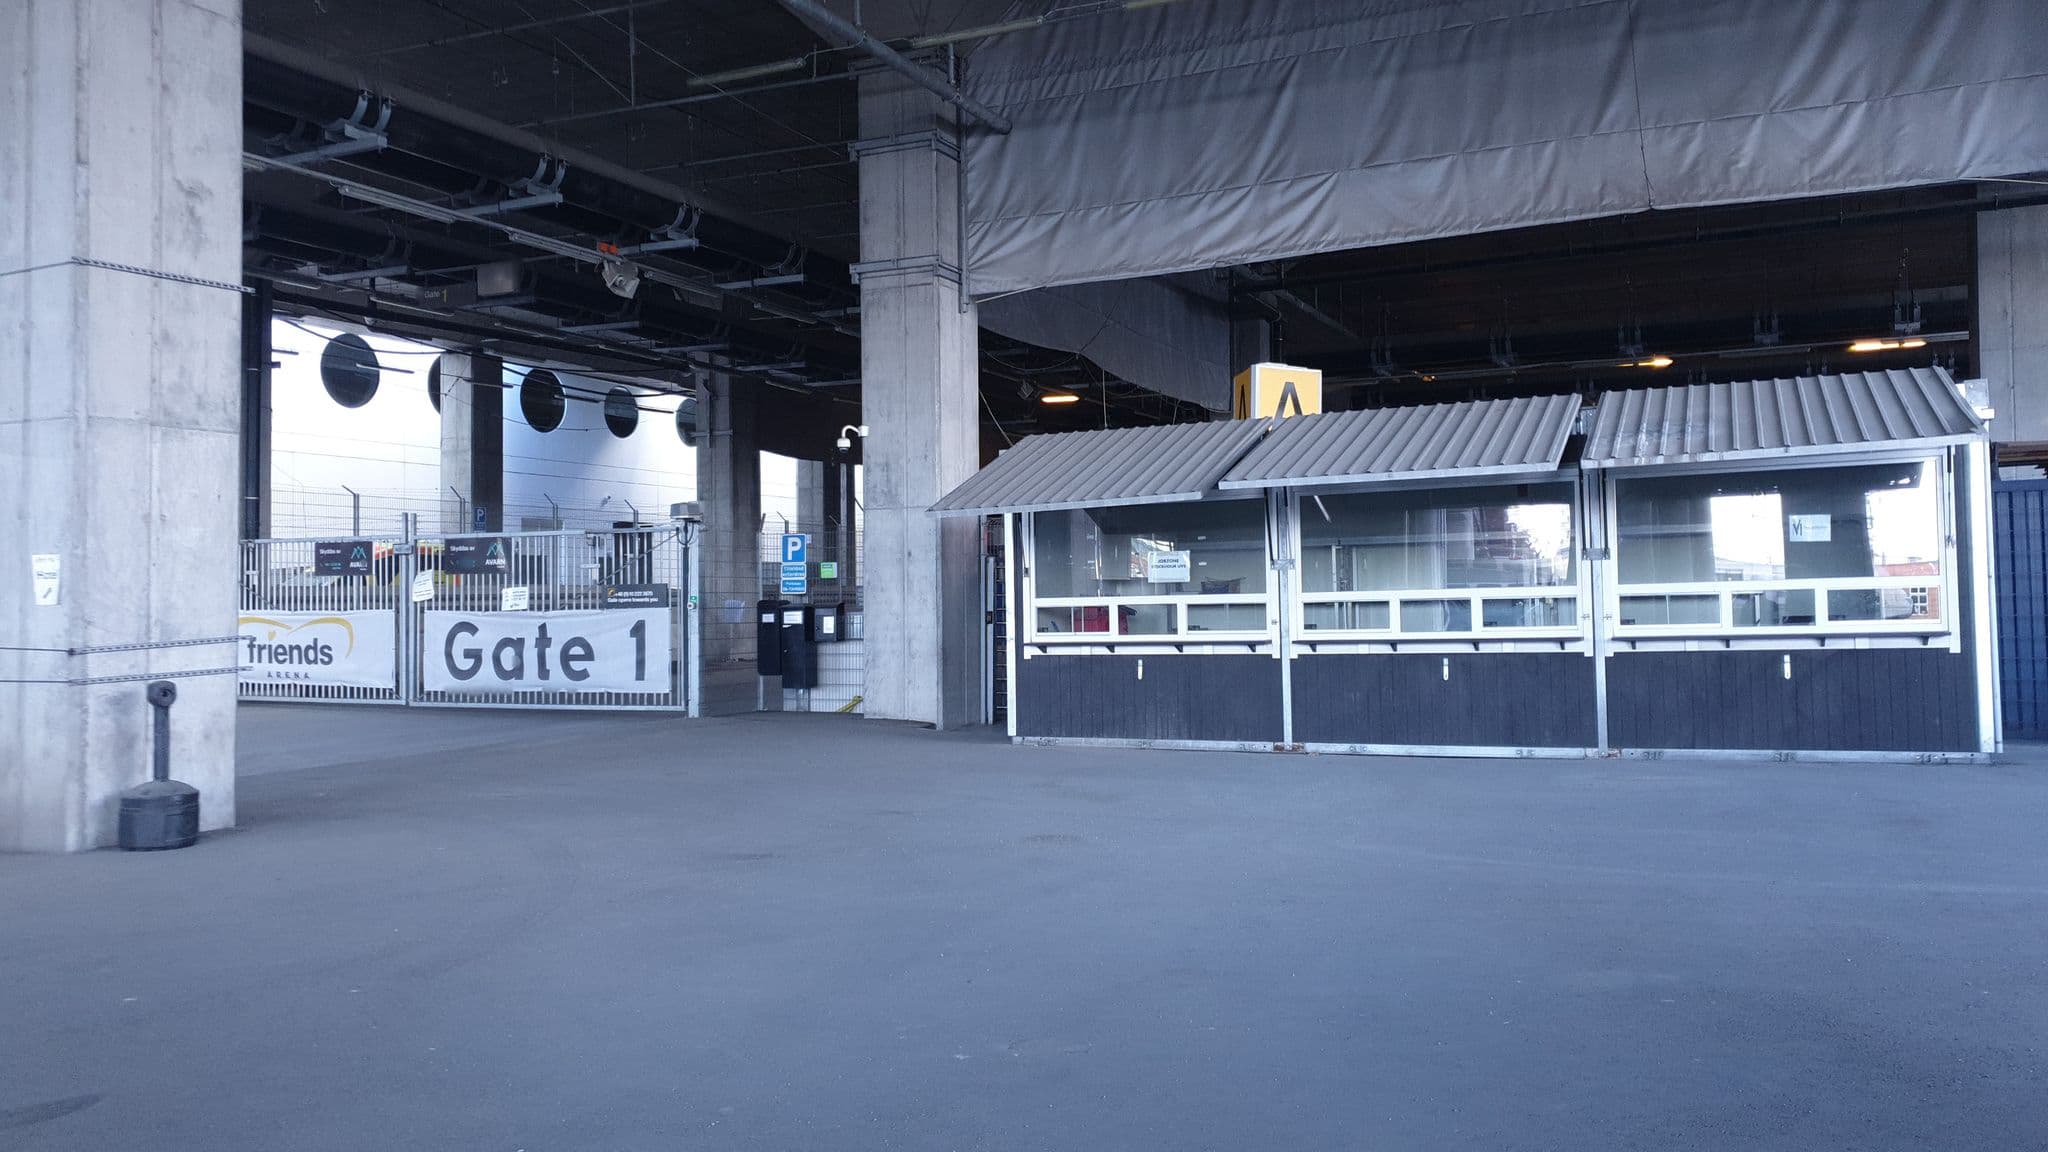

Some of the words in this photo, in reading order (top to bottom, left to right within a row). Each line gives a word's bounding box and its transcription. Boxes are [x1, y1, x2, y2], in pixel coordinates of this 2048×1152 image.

[476, 508, 485, 521] P
[787, 536, 802, 561] P
[247, 636, 333, 666] friends
[444, 620, 595, 682] Gate
[629, 619, 646, 681] 1
[267, 671, 310, 679] ARENA
